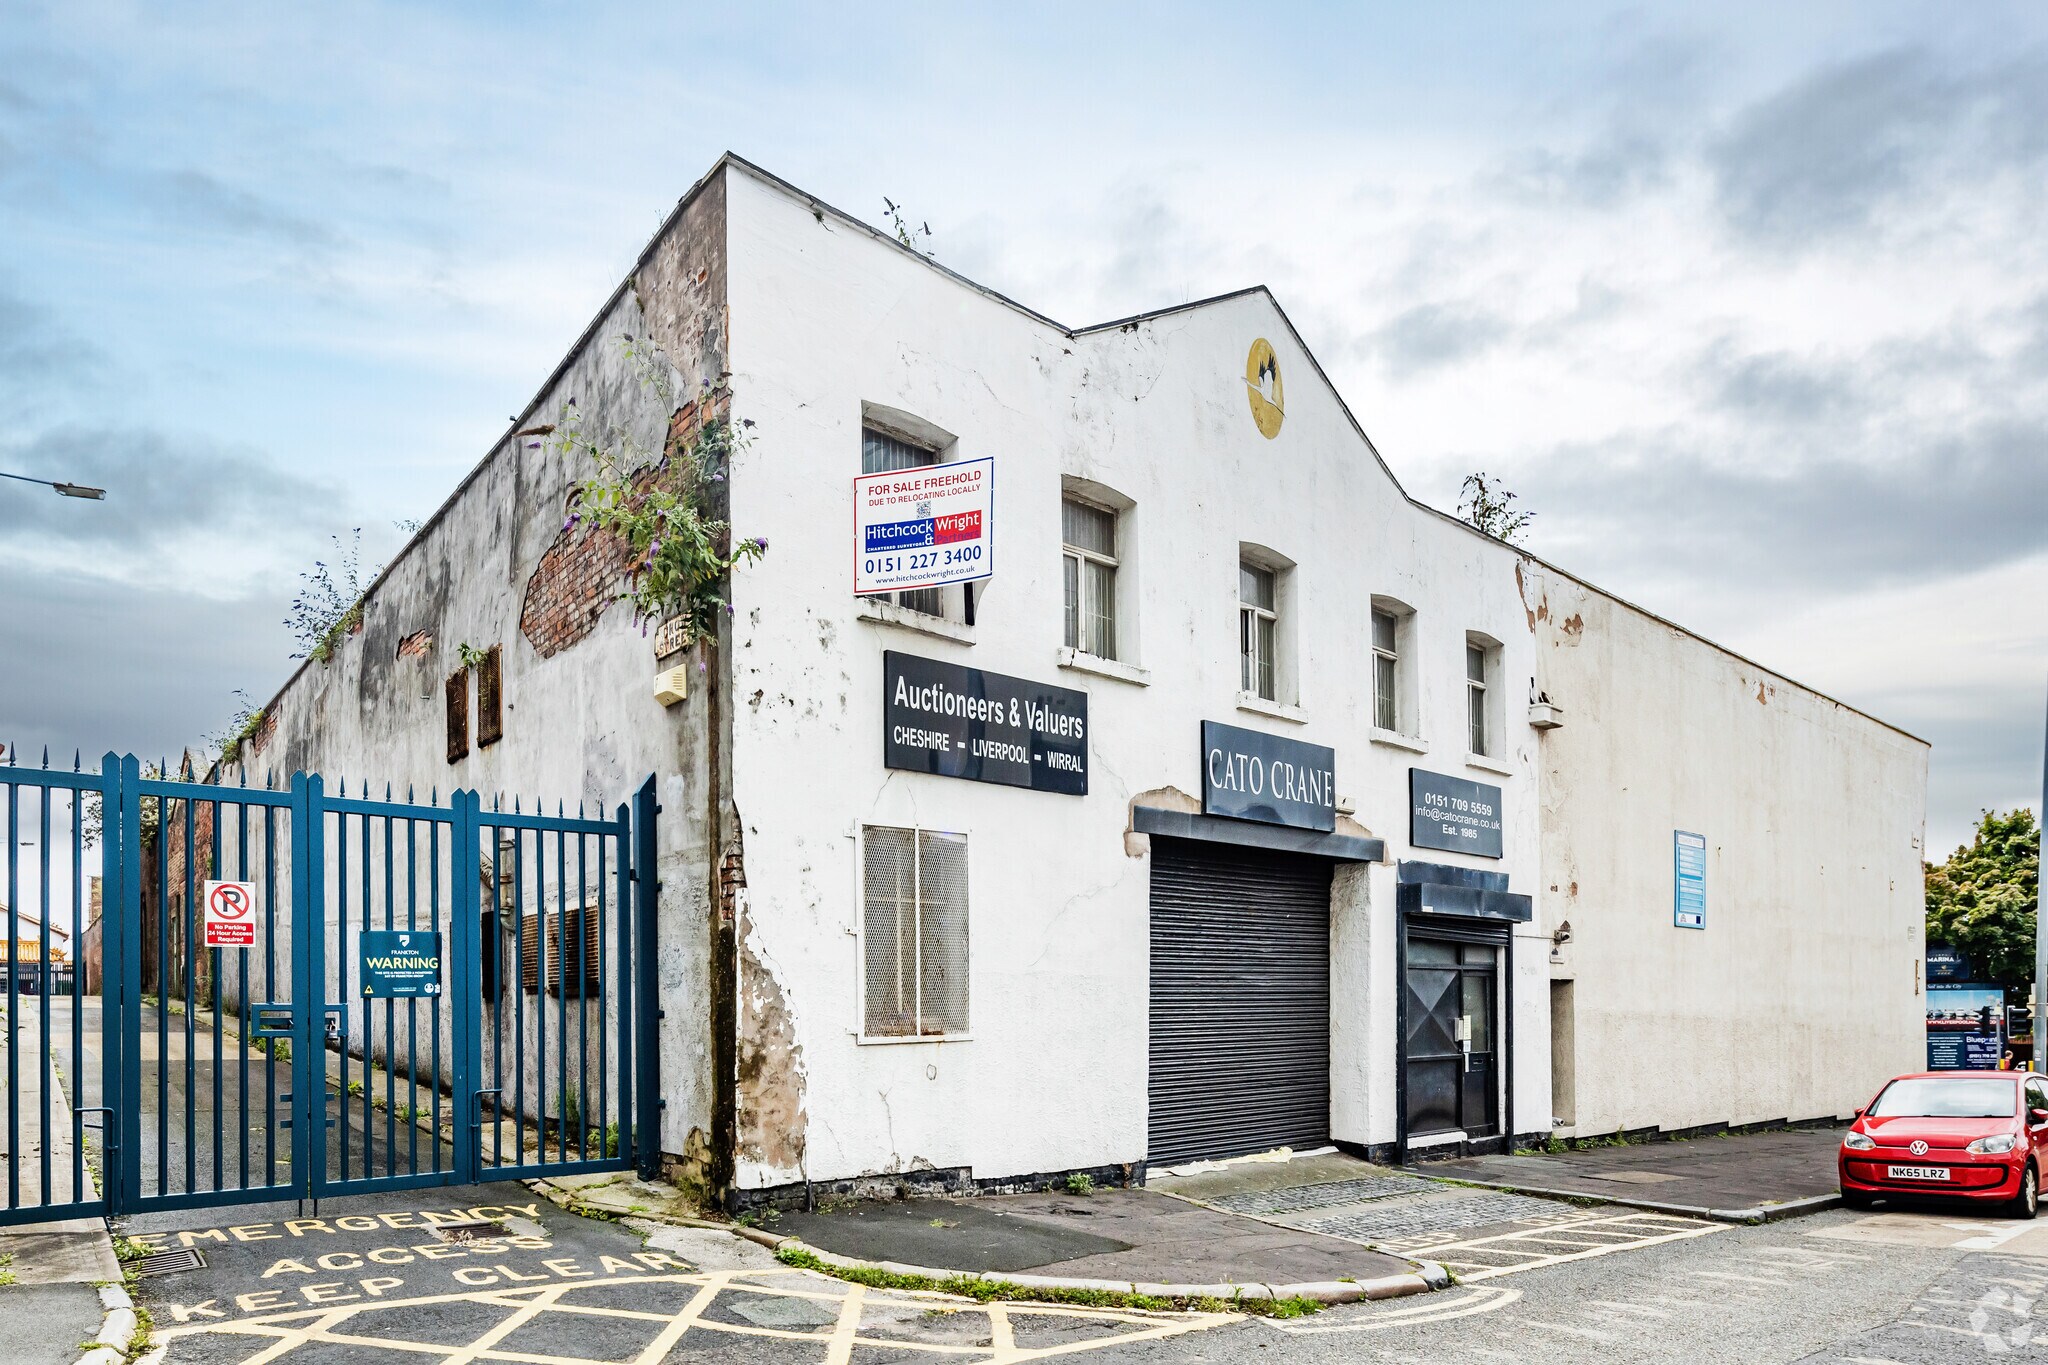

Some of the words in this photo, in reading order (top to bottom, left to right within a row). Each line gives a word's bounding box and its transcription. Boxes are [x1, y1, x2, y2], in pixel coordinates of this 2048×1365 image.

[869, 485, 890, 496] FOR
[893, 480, 921, 493] SALE
[924, 470, 981, 489] FREEHOLD
[869, 499, 884, 507] DUE
[887, 497, 897, 505] TO
[899, 490, 945, 503] RELOCATING
[948, 484, 981, 496] LOCALLY
[867, 520, 933, 540] Hitchcock
[936, 513, 979, 531] Wright
[925, 534, 934, 545] &
[936, 530, 980, 543] Partners
[866, 557, 901, 574] 0151
[910, 552, 938, 570] 227
[944, 545, 981, 565] 3400
[876, 565, 975, 584] www.hitchcockwright.co.uk
[894, 675, 1004, 724] Auctioneers
[1009, 697, 1021, 728] &
[1025, 700, 1083, 739] Valuers
[894, 725, 950, 752] CHESHIRE
[973, 738, 1029, 764] LIVERPOOL
[1047, 751, 1083, 773] WIRRAL
[1209, 748, 1264, 795] CATO
[1271, 760, 1332, 808] CRANE
[1415, 805, 1501, 830] info@catocrane.co.uk
[1425, 792, 1448, 808] 0151
[1451, 798, 1468, 812] 709
[1471, 802, 1492, 817] 5559
[1442, 824, 1458, 836] Est.
[1461, 828, 1478, 839] 1985
[366, 957, 439, 969] WARNING
[1892, 1167, 1920, 1178] NK65
[1923, 1168, 1945, 1179] LRZ
[128, 1203, 541, 1251] EMERGENCY
[260, 1235, 553, 1279] ACCESS
[170, 1276, 405, 1322] KEEP
[452, 1252, 692, 1286] CLEAR
